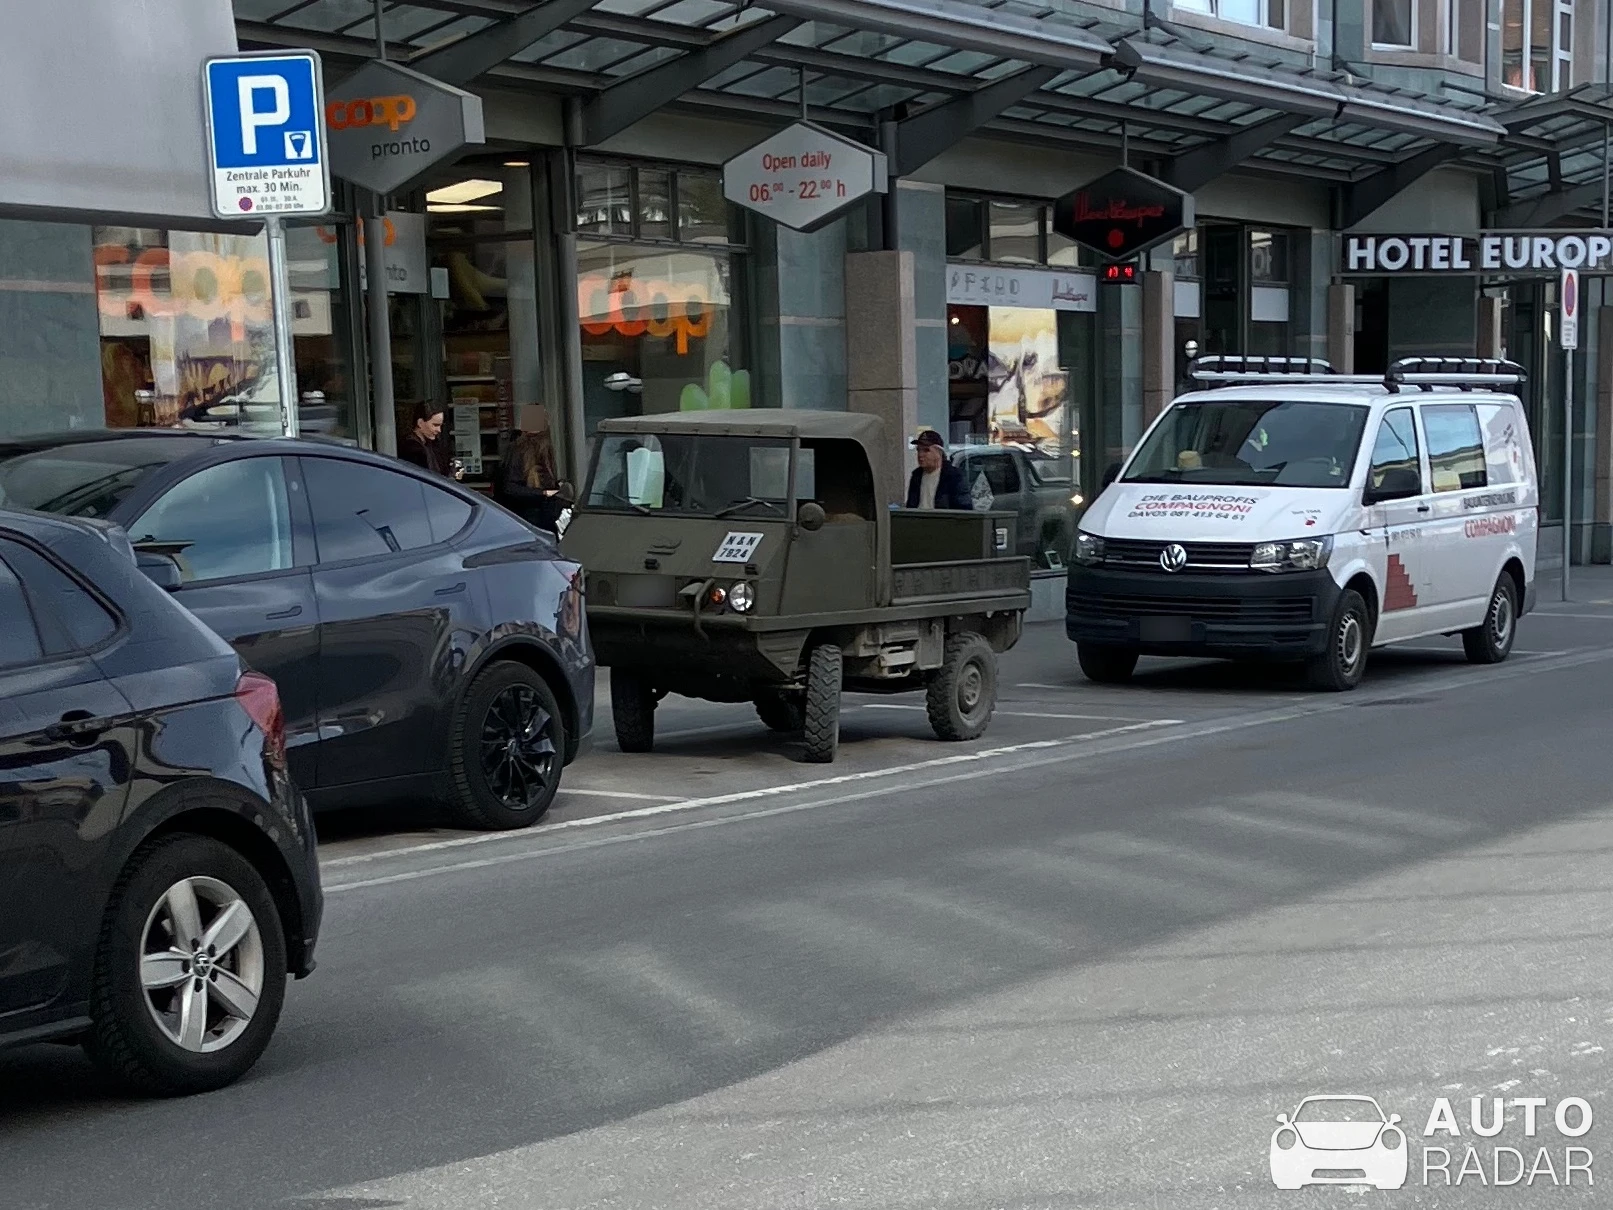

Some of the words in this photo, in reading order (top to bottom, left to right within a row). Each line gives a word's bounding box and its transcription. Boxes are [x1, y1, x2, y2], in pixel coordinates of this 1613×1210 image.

[237, 74, 290, 155] P
[325, 95, 416, 132] coop
[371, 137, 430, 160] pronto
[762, 153, 797, 172] Open
[801, 150, 832, 169] daily
[226, 169, 269, 181] Zentrale
[271, 167, 310, 180] Parkuhr
[236, 186, 261, 194] max.
[264, 182, 277, 193] 30
[280, 182, 303, 192] Min.
[836, 179, 846, 197] h
[1349, 238, 1471, 270] HOTEL
[578, 274, 716, 355] coop
[1134, 502, 1252, 513] COMPAGNONI
[1141, 494, 1169, 502] DIE
[1170, 494, 1259, 504] BAUPROFIS
[1127, 510, 1167, 518] DAVOS
